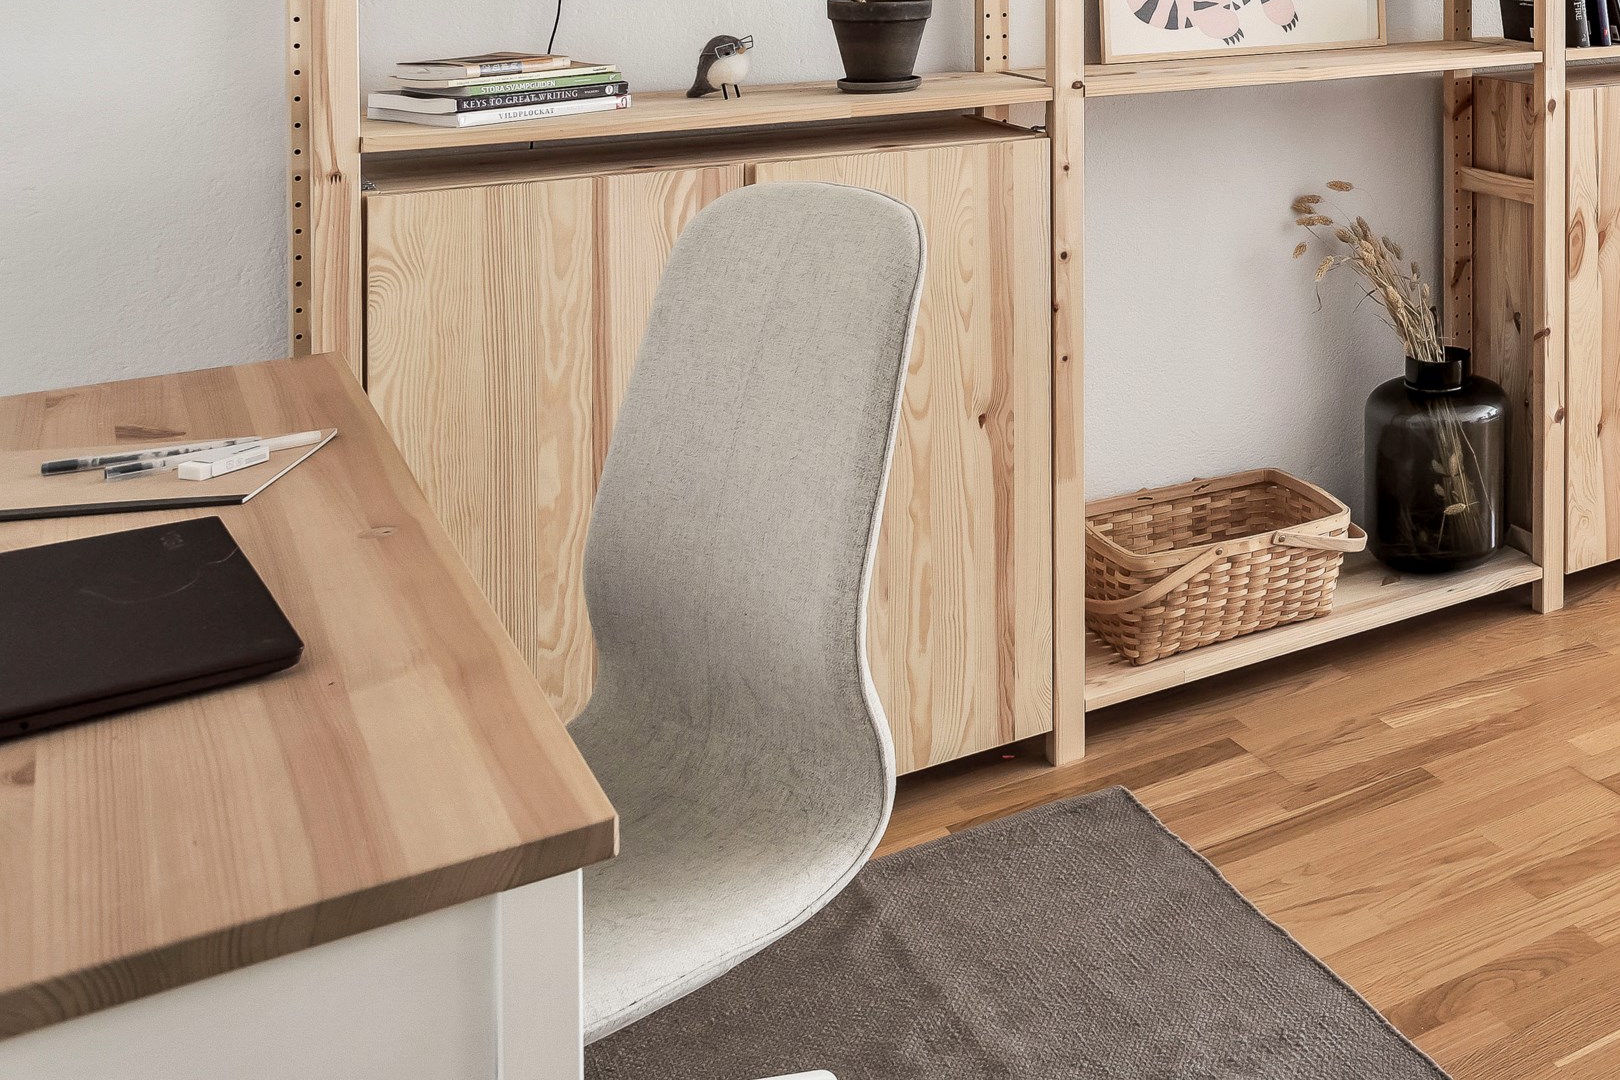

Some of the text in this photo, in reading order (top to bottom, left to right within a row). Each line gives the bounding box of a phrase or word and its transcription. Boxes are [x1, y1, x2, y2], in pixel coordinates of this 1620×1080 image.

[1573, 2, 1582, 20] FIRE
[481, 80, 556, 93] STORA SVAMPGUIDEN
[463, 90, 578, 108] KEYS TO GREAT WRITING
[498, 108, 554, 120] VILDPLOCKAT
